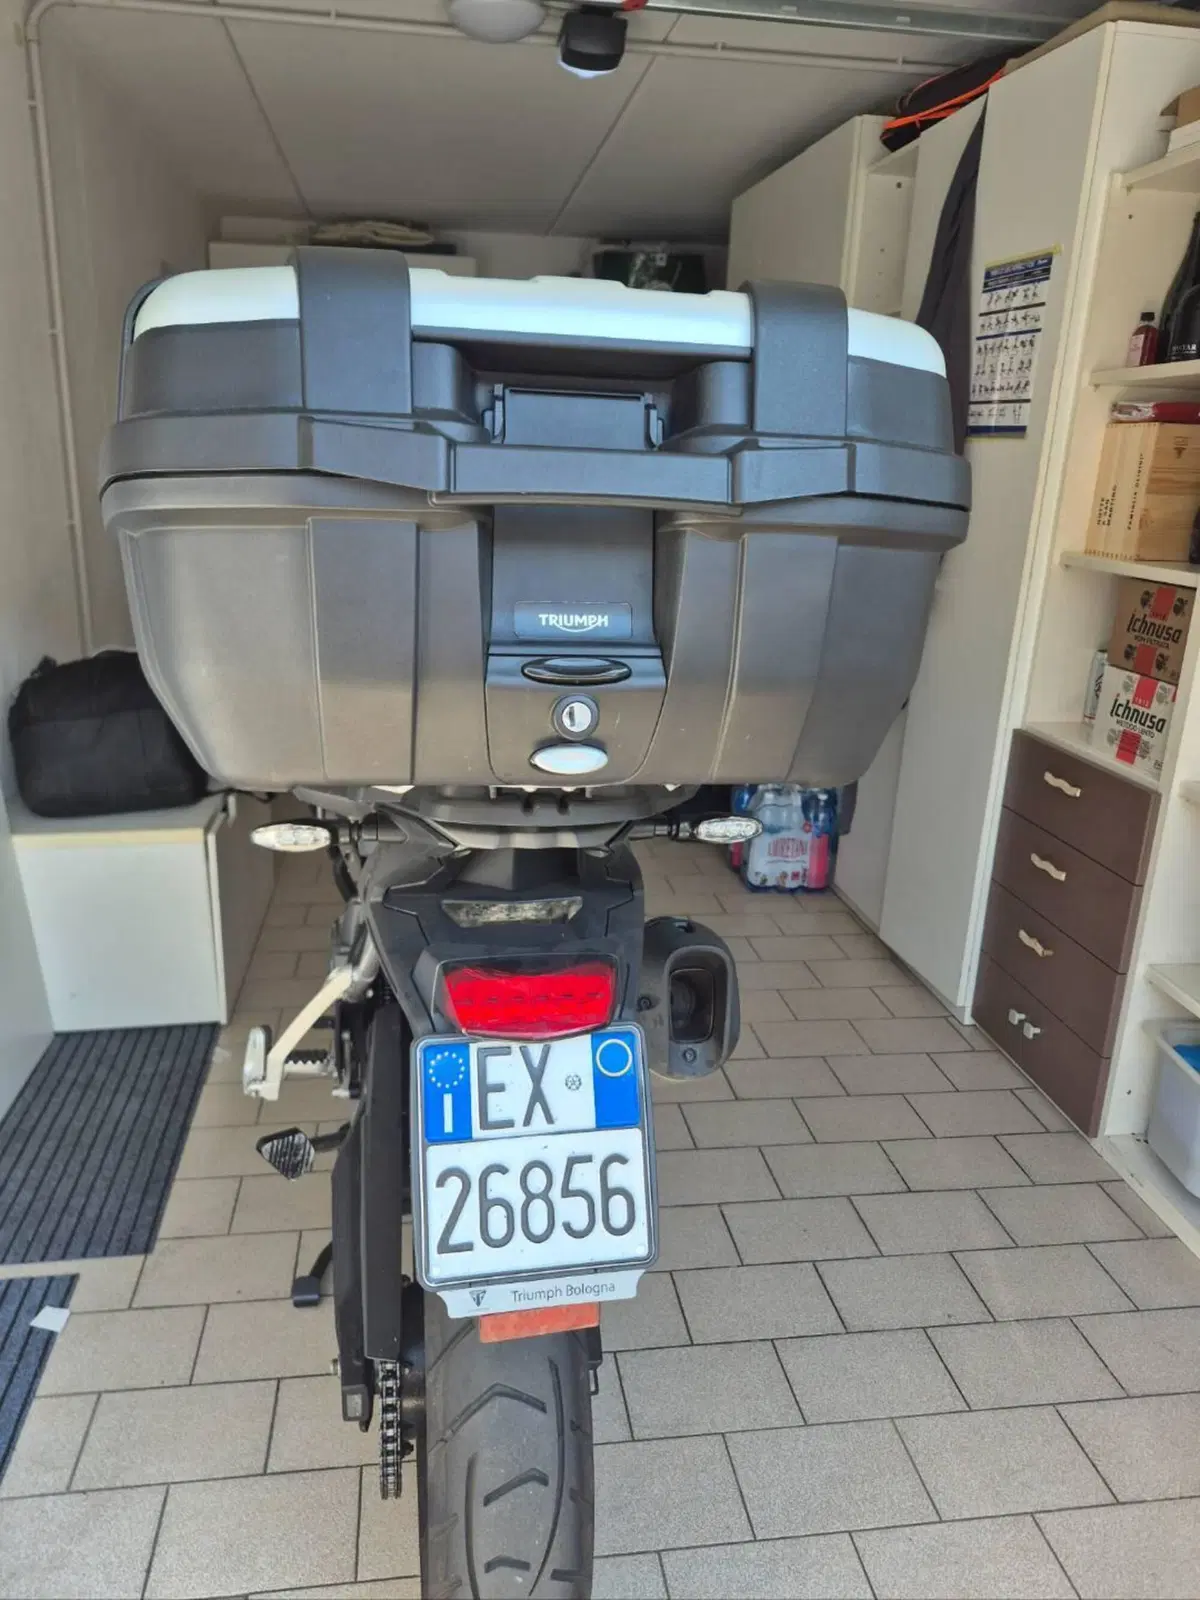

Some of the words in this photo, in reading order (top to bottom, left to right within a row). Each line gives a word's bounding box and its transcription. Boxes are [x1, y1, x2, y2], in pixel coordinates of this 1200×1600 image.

[538, 613, 609, 632] TRIUMPH
[476, 1044, 555, 1131] EX
[435, 1153, 636, 1254] 26856
[511, 1285, 563, 1303] Triumph
[566, 1281, 616, 1300] Bologna
